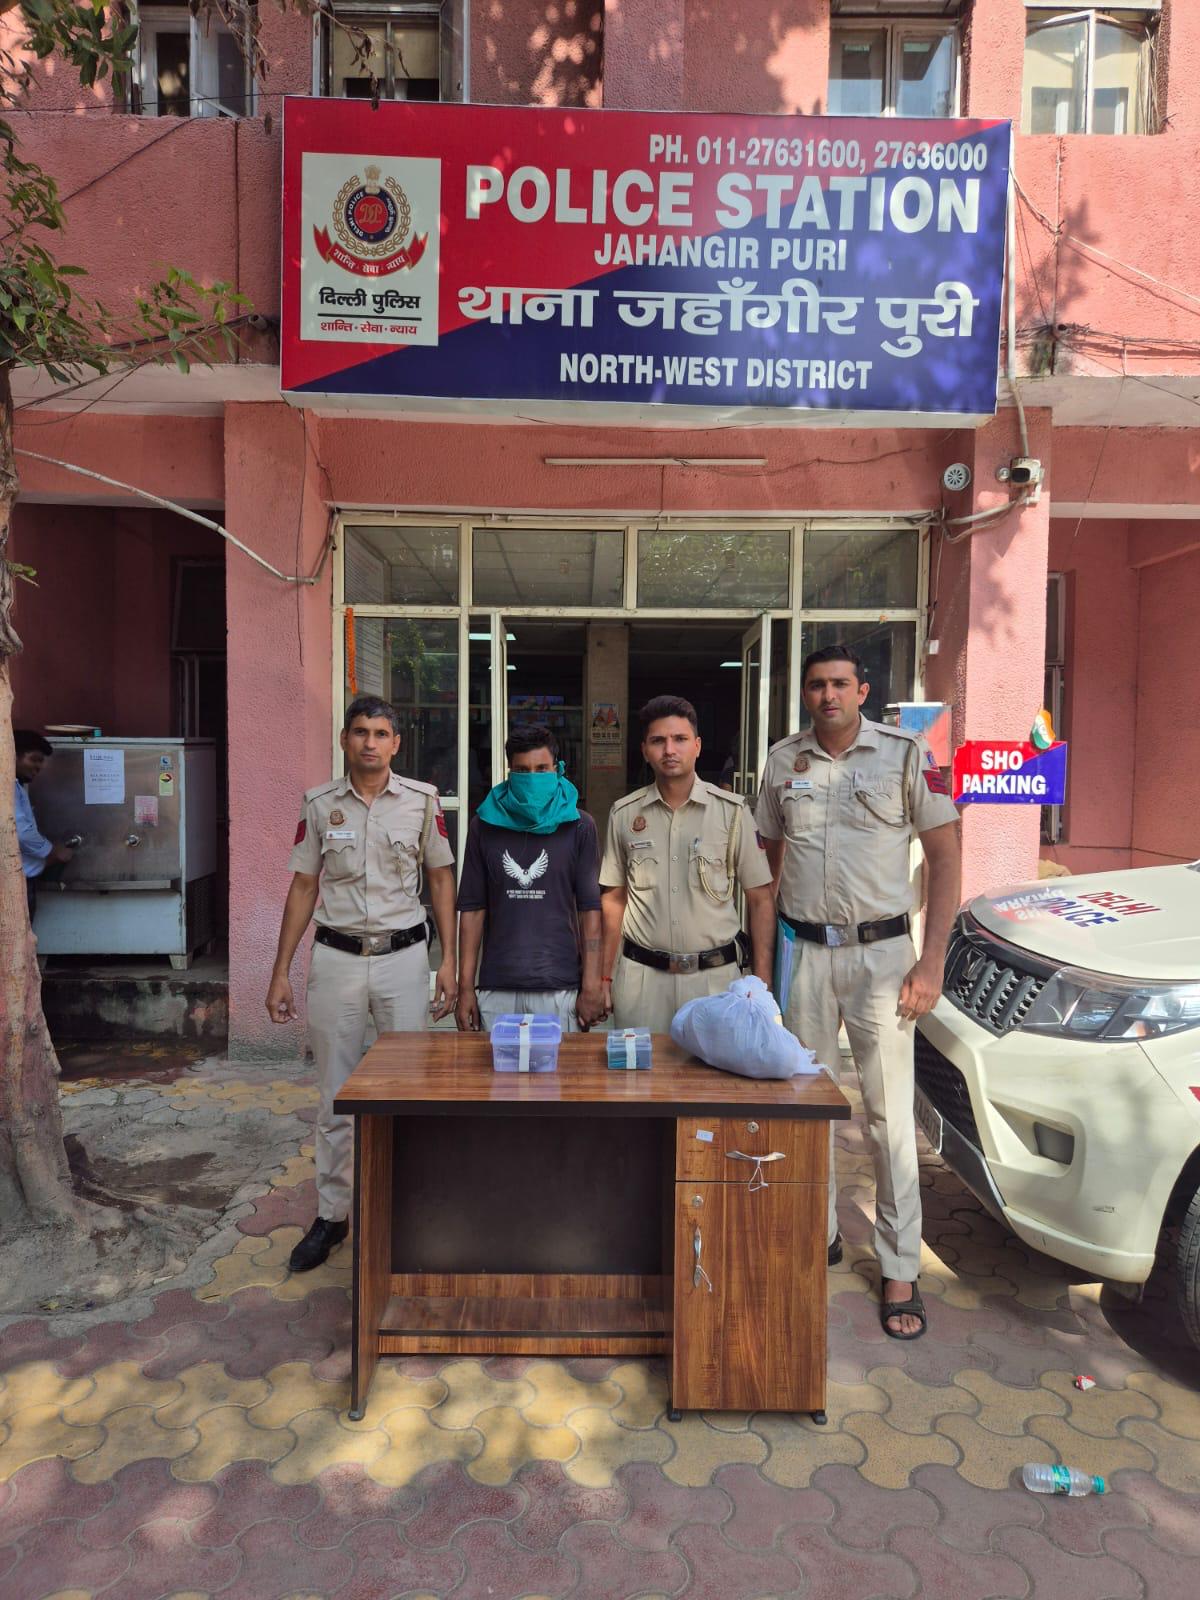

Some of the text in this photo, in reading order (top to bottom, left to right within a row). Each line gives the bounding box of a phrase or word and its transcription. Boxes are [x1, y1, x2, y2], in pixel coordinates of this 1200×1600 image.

[650, 135, 988, 175] PH. 011-27631600, 27636000
[465, 164, 695, 229] POLICE
[715, 173, 981, 234] STATION
[594, 233, 848, 271] JAHANGIR PURI
[318, 286, 422, 315] दिल्ली पुलिस
[319, 319, 417, 336] शान्ति सेवा न्याय
[458, 276, 980, 358] थाना जहाँगीर पुरी
[560, 353, 873, 390] NORTH-WEST DISTRICT
[981, 749, 1023, 771] SHO
[962, 774, 1047, 795] PARKING
[1031, 896, 1120, 928] POLICE
[1077, 891, 1161, 916] DELHI
